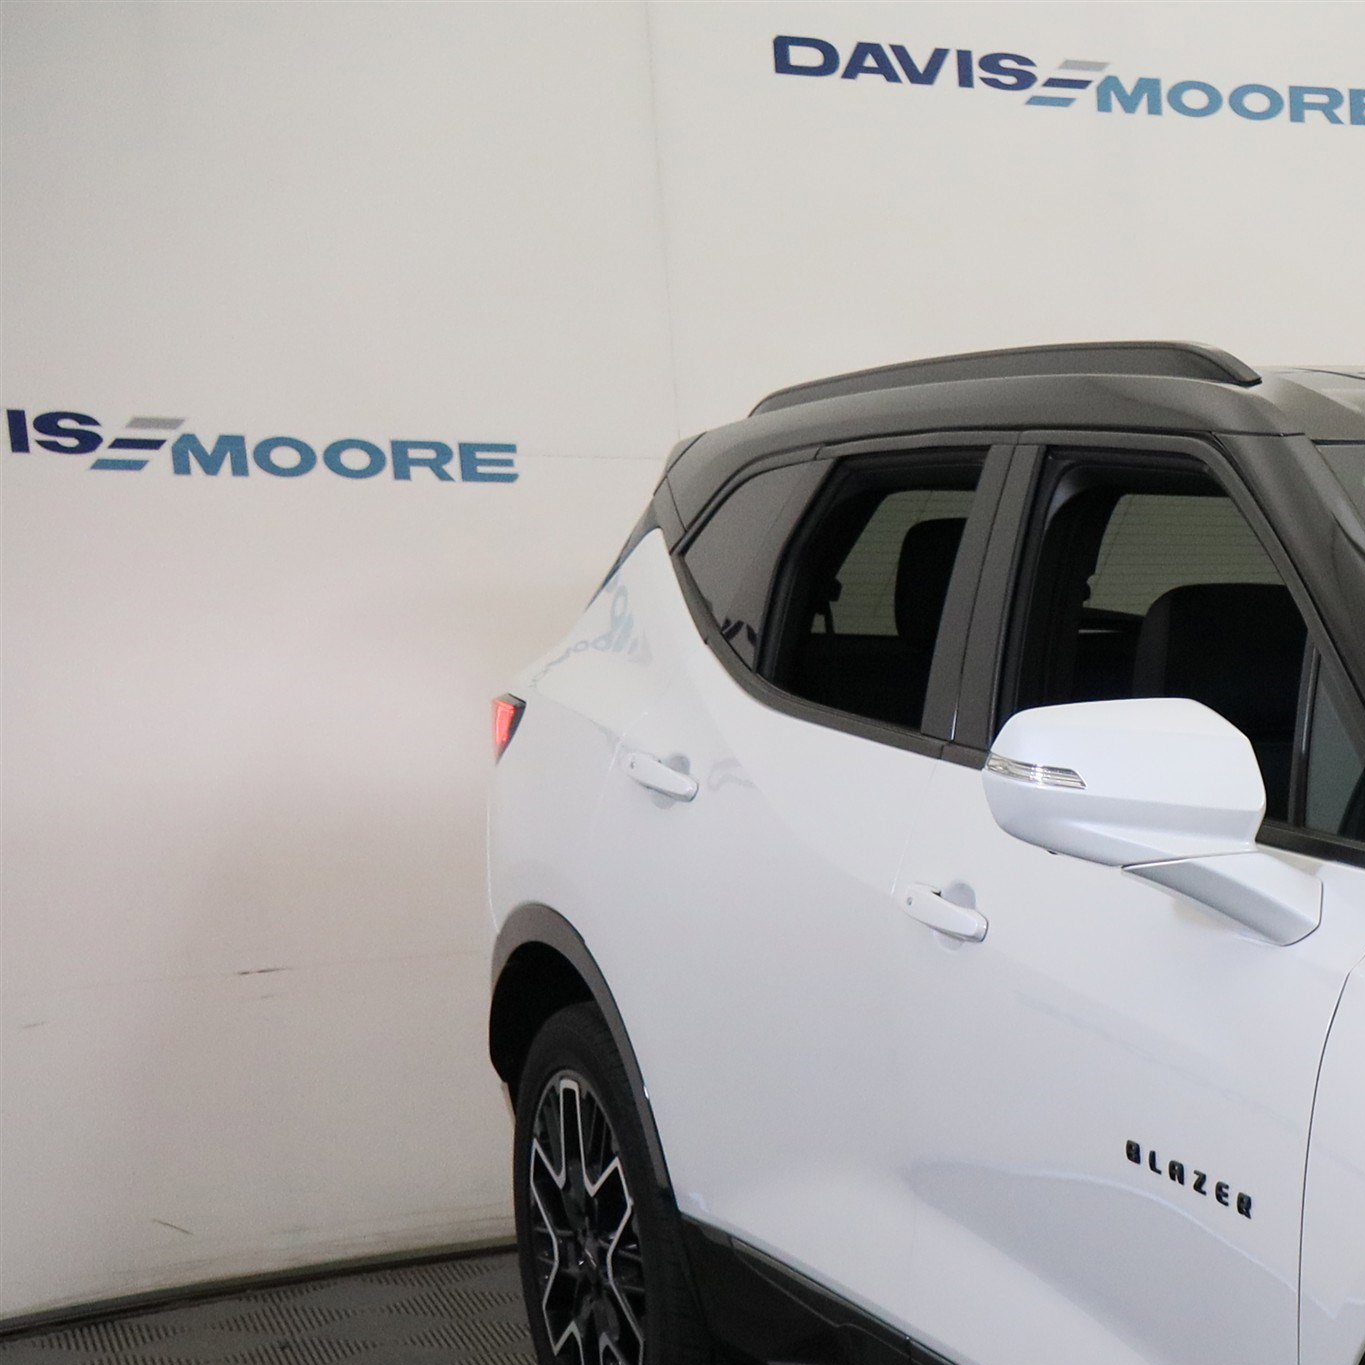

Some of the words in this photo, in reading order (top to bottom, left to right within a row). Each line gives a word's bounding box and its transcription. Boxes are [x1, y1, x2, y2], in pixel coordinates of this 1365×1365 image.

[772, 34, 1038, 91] DAVIS
[171, 432, 519, 483] MOORE
[1125, 1139, 1253, 1220] BLAZER
